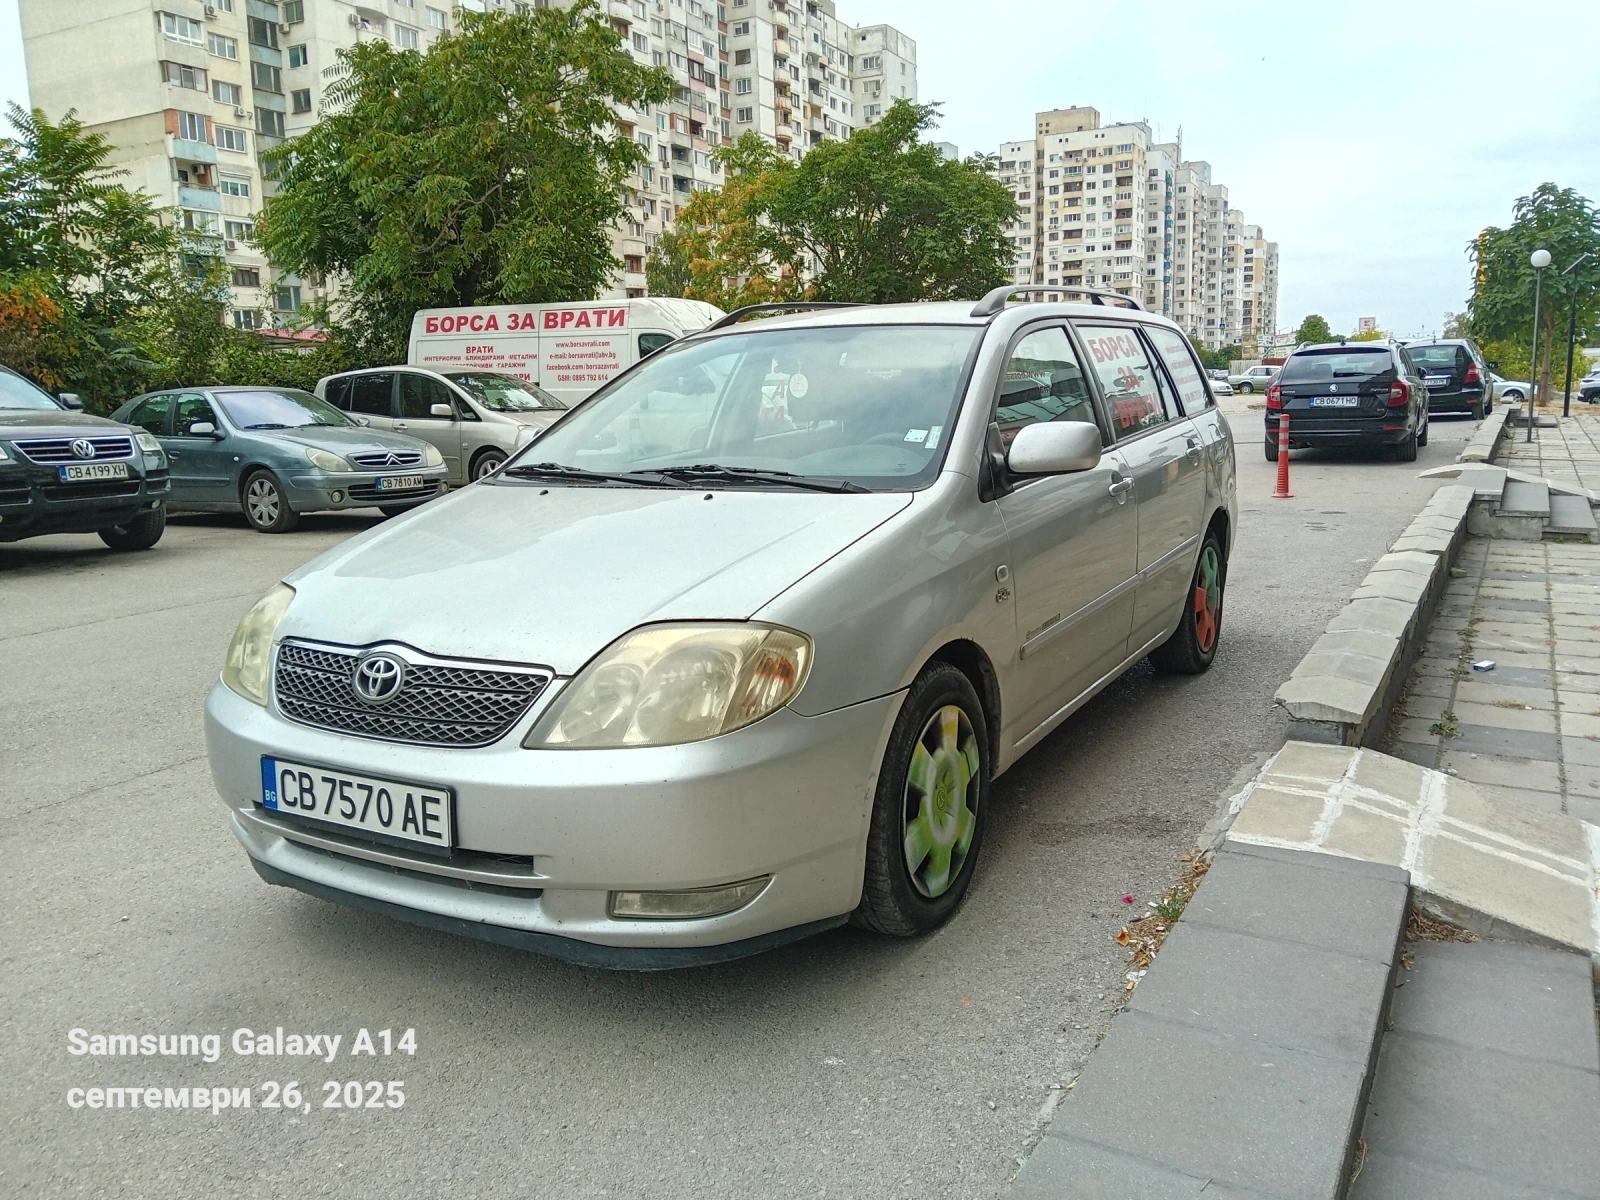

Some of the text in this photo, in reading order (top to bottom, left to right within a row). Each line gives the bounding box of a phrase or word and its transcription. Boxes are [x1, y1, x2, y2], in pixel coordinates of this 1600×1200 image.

[425, 309, 626, 333] БОРСА ЗА ВРАТИ
[465, 345, 494, 354] ВРАТИ
[555, 340, 610, 348] www.borsavrati.com
[1088, 335, 1140, 363] БОРСА
[549, 352, 567, 360] e-mail:
[557, 372, 608, 382] GSM: 0895 792 614
[1118, 366, 1140, 391] ЗА
[1315, 397, 1325, 405] CB
[1326, 396, 1344, 405] 0671
[1115, 392, 1161, 429] ВРАТИ
[67, 467, 83, 479] CB
[85, 465, 110, 478] 4199
[111, 464, 126, 476] XH
[382, 477, 423, 488] CB 7810 AM
[264, 790, 277, 802] BG
[280, 769, 443, 840] CB 7570 AE
